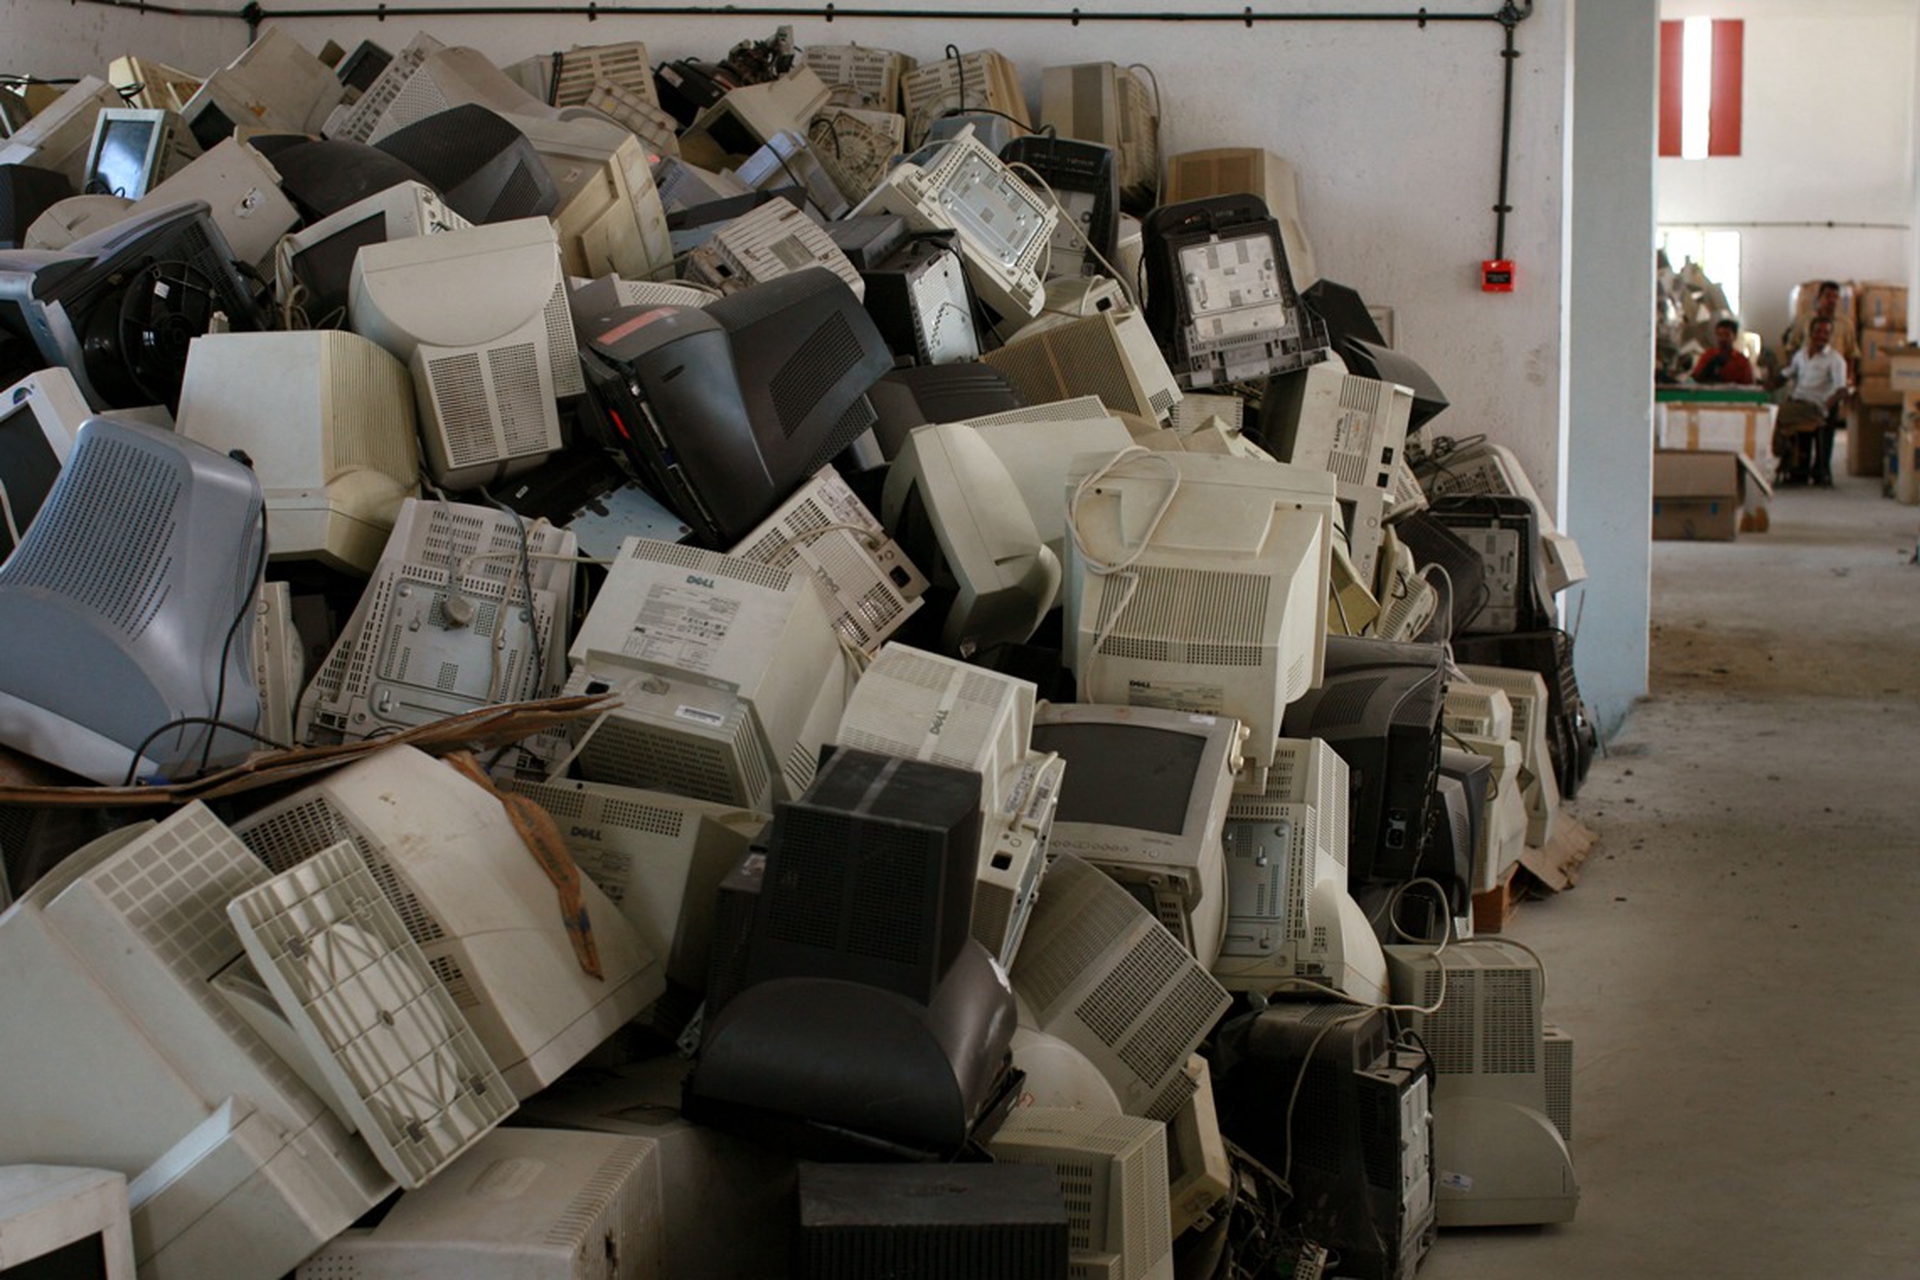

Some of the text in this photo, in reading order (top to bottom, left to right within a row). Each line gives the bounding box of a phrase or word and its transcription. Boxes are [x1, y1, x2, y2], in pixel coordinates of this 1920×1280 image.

[686, 575, 714, 588] DELL
[929, 709, 948, 735] DELL
[571, 826, 601, 840] DELL
